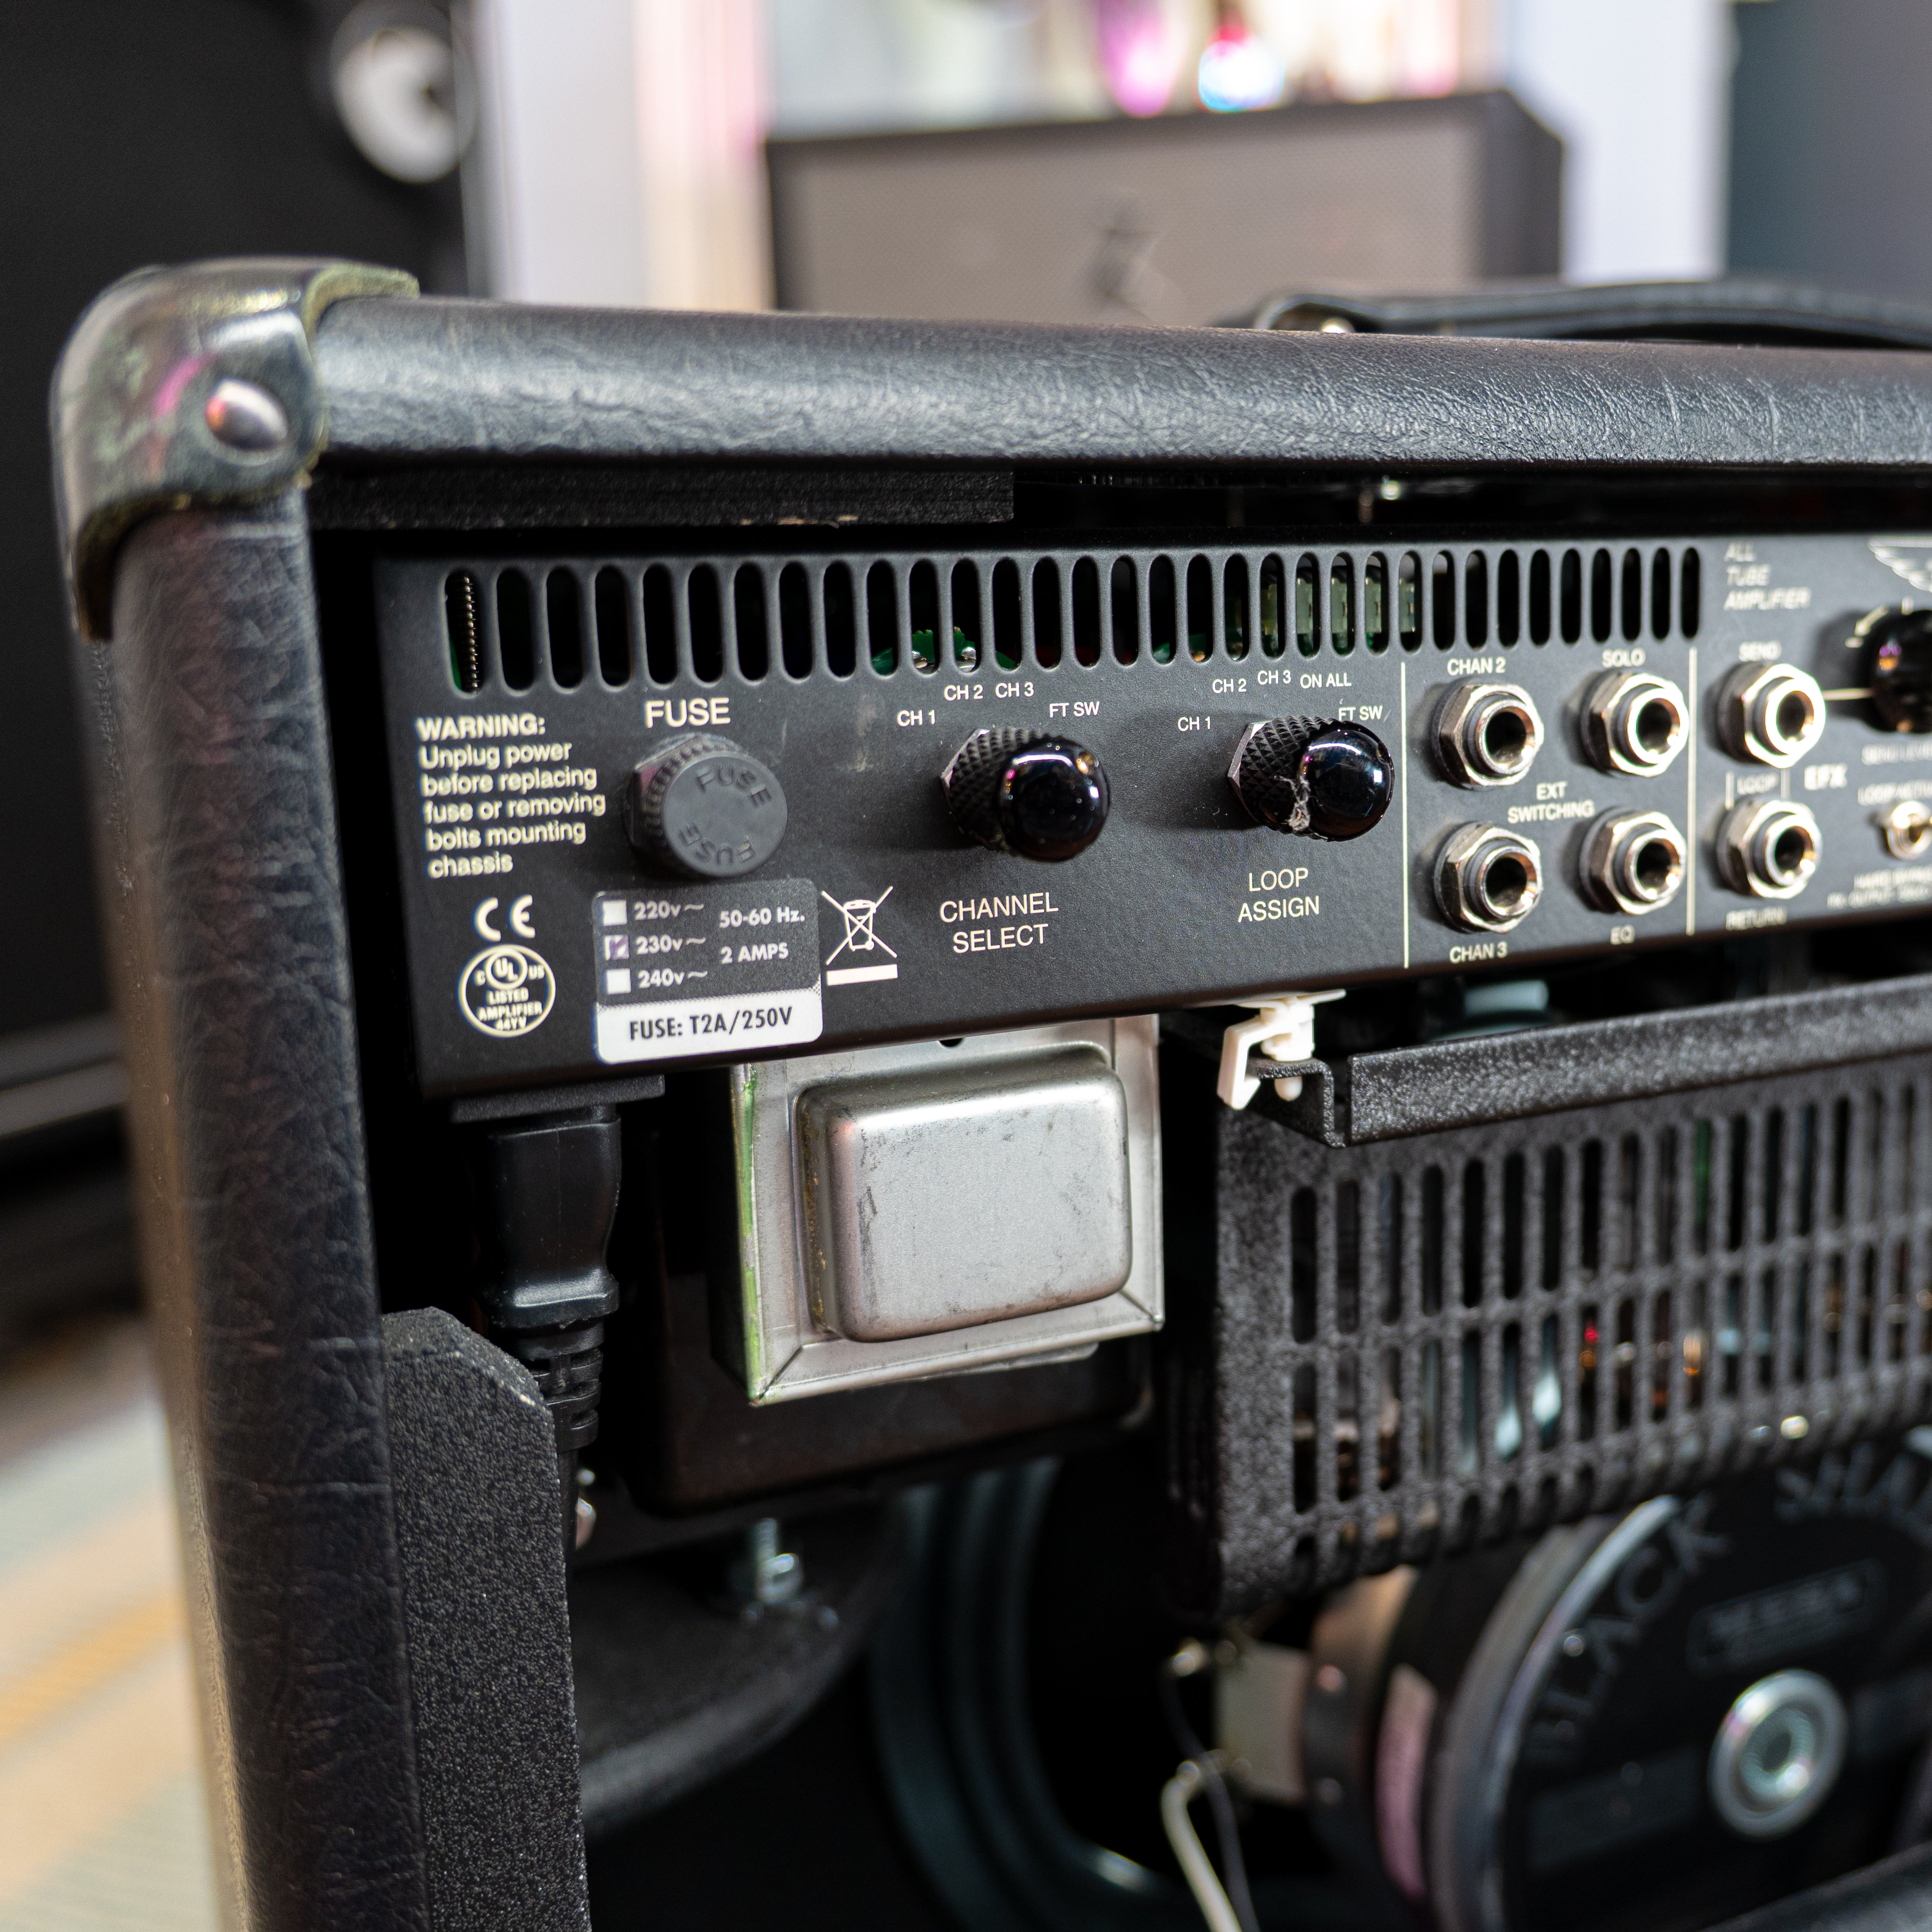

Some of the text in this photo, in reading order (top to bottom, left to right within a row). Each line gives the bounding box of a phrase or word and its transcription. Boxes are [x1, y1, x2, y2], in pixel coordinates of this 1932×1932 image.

[1724, 542, 1756, 563] ALL
[1726, 564, 1771, 586] TUBE
[1602, 648, 1646, 668] SOLO
[1739, 641, 1781, 662] SEND
[1447, 657, 1506, 676] CHAN 2
[1212, 678, 1247, 694] CH 2
[1257, 670, 1291, 686] CH 3
[1300, 673, 1352, 689] ON ALL
[944, 684, 983, 701] CH 2
[995, 682, 1034, 698] CH 3
[644, 697, 731, 728] FUSE
[897, 710, 936, 727] CH 1
[1049, 701, 1099, 718] FT SW
[1339, 705, 1383, 721] FT SW
[416, 713, 545, 742] WARNING:
[1177, 717, 1211, 732] CH 1
[421, 742, 572, 771] Unplug power
[421, 766, 597, 797] before replacing
[695, 763, 771, 807] FUSE
[1804, 763, 1848, 790] EFX
[1536, 782, 1568, 801] EXT
[424, 792, 606, 824] fuse or removing
[1508, 801, 1595, 824] SWITCHING
[425, 820, 586, 852] bolts mounting
[428, 851, 513, 878] chassis
[1249, 867, 1308, 892] LOOP
[719, 906, 805, 929] 50-60 Hz.
[940, 892, 1059, 923] CHANNEL
[1238, 895, 1319, 923] ASSIGN
[1726, 906, 1787, 930] RETURN
[953, 923, 1048, 954] SELECT
[1610, 926, 1635, 945] EQ
[720, 942, 789, 964] 2 AMPS
[1449, 941, 1508, 964] CHAN 3
[487, 987, 529, 1005] LISTED
[477, 1001, 542, 1021] AMPLIFIER
[630, 1006, 792, 1041] FUSE: T2A/250V
